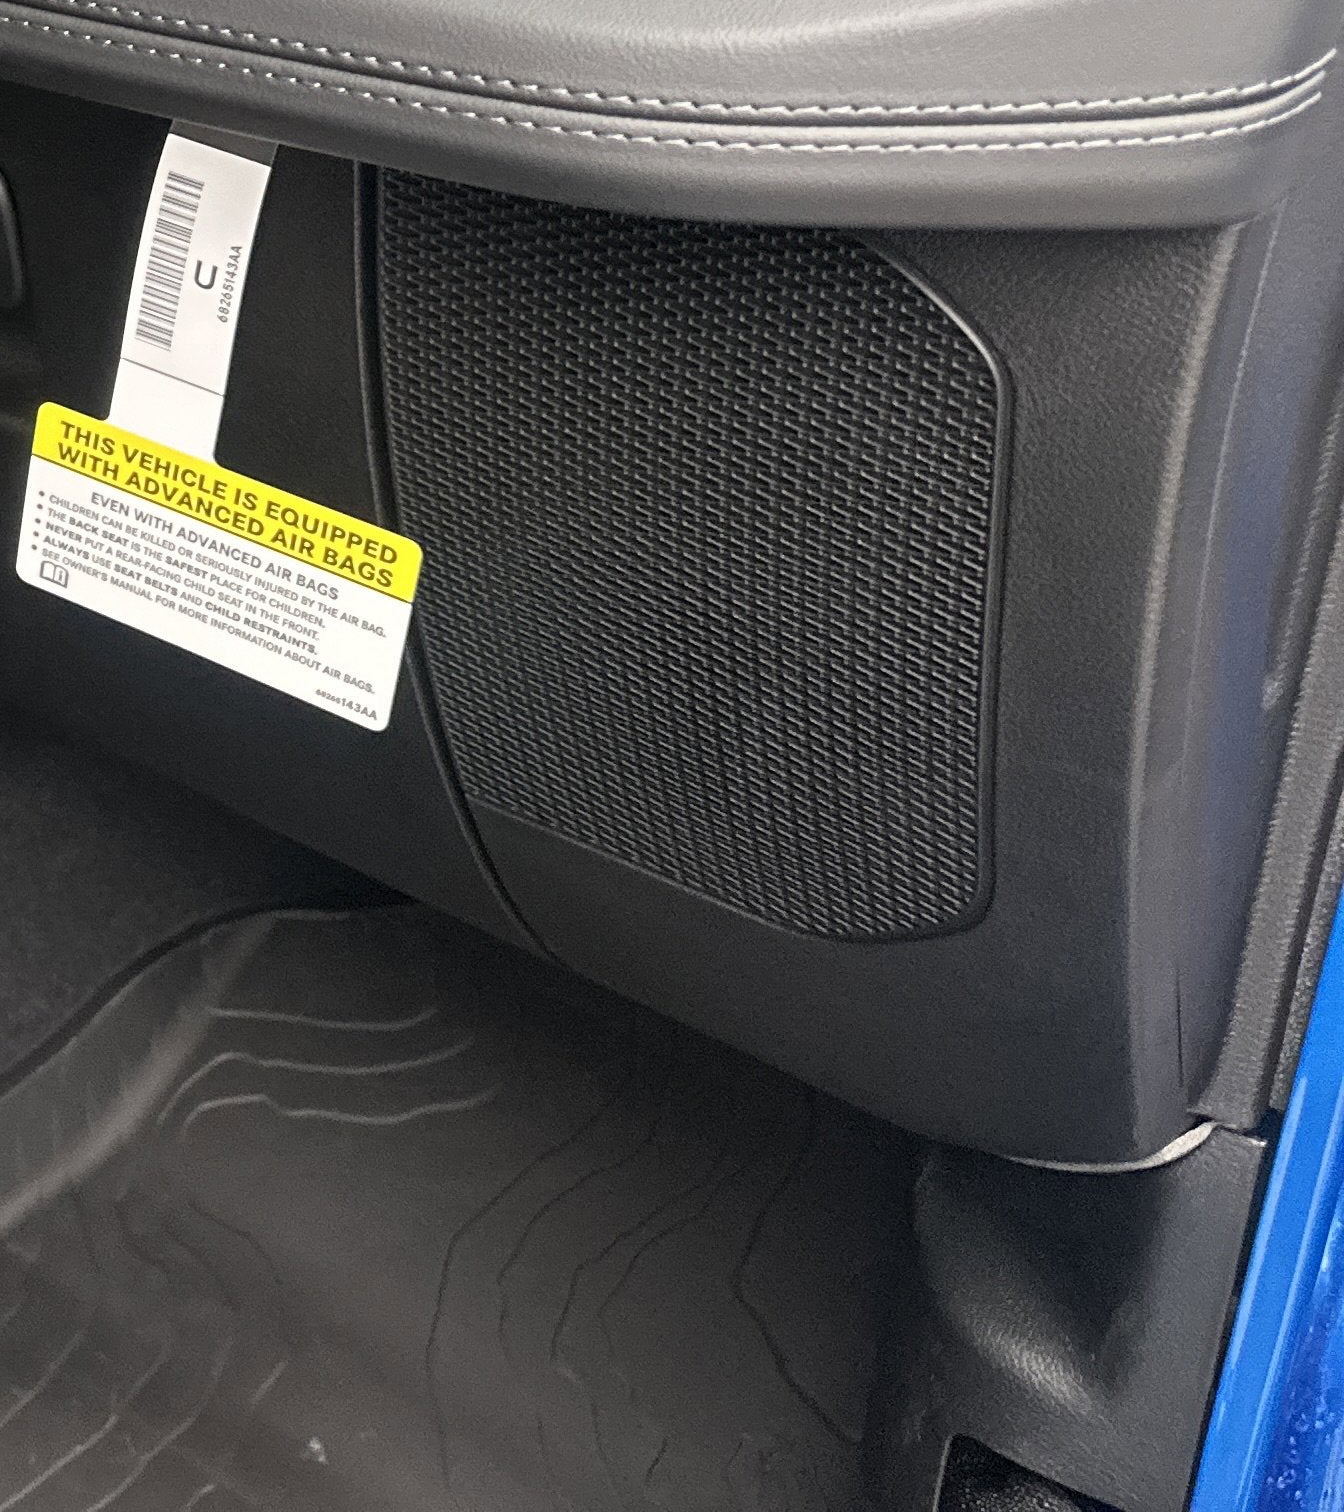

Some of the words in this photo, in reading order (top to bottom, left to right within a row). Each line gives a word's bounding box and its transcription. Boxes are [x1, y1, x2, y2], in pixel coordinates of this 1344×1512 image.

[194, 260, 217, 290] U
[217, 245, 243, 324] 68265143AA
[56, 441, 119, 481] WITH
[124, 468, 265, 538] ADVANCED
[270, 525, 316, 558] AIR
[322, 545, 393, 589] BAGS
[59, 419, 115, 457] THIS
[120, 443, 227, 500] VEHICLE
[233, 487, 258, 512] IS
[264, 499, 398, 566] EQUIPPED
[90, 491, 129, 517] EVEN
[133, 508, 173, 534] WITH
[176, 525, 262, 570] ADVANCED
[264, 560, 292, 582] AIR
[295, 573, 339, 601] BAGS
[41, 547, 59, 562] SEE
[61, 555, 108, 582] OWNER'S
[109, 575, 153, 601] MANUAL
[154, 594, 176, 610] FOR
[177, 603, 208, 624] MORE
[210, 617, 282, 655] INFORMATION
[283, 648, 321, 672] ABOUT
[321, 664, 341, 680] AIR
[343, 673, 376, 694] BAGS.
[43, 534, 90, 560] ALWAYS
[91, 553, 111, 569] USE
[113, 562, 142, 582] SEAT
[144, 575, 178, 597] BELTS
[179, 590, 202, 607] AND
[204, 600, 241, 623] CHILD
[243, 616, 318, 655] RESTRAINTS.
[45, 520, 82, 543] NEVER
[84, 536, 104, 552] PUT
[105, 545, 113, 556] A
[115, 549, 181, 584] REAR-FACING
[183, 576, 215, 598] CHILD
[217, 590, 243, 609] SEAT
[244, 602, 257, 614] IN
[258, 607, 280, 624] THE
[281, 617, 320, 641] FRONT.
[47, 507, 66, 522] THE
[68, 516, 99, 536] BACK
[101, 529, 129, 548] SEAT
[130, 541, 141, 553] IS
[142, 545, 163, 562] THE
[164, 555, 208, 580] SAFEST
[209, 573, 243, 594] PLACE
[245, 587, 267, 604] FOR
[268, 597, 326, 628] CHILDREN.
[48, 493, 99, 522] CHILDREN
[101, 514, 123, 531] CAN
[125, 524, 138, 537] BE
[139, 529, 176, 552] KILLED
[177, 545, 193, 559] OR
[195, 552, 252, 583] SERIOUSLY
[253, 576, 299, 603] INJURED
[300, 595, 315, 609] BY
[316, 601, 338, 618] THE
[339, 610, 359, 627] AIR
[360, 619, 387, 638] BAG.
